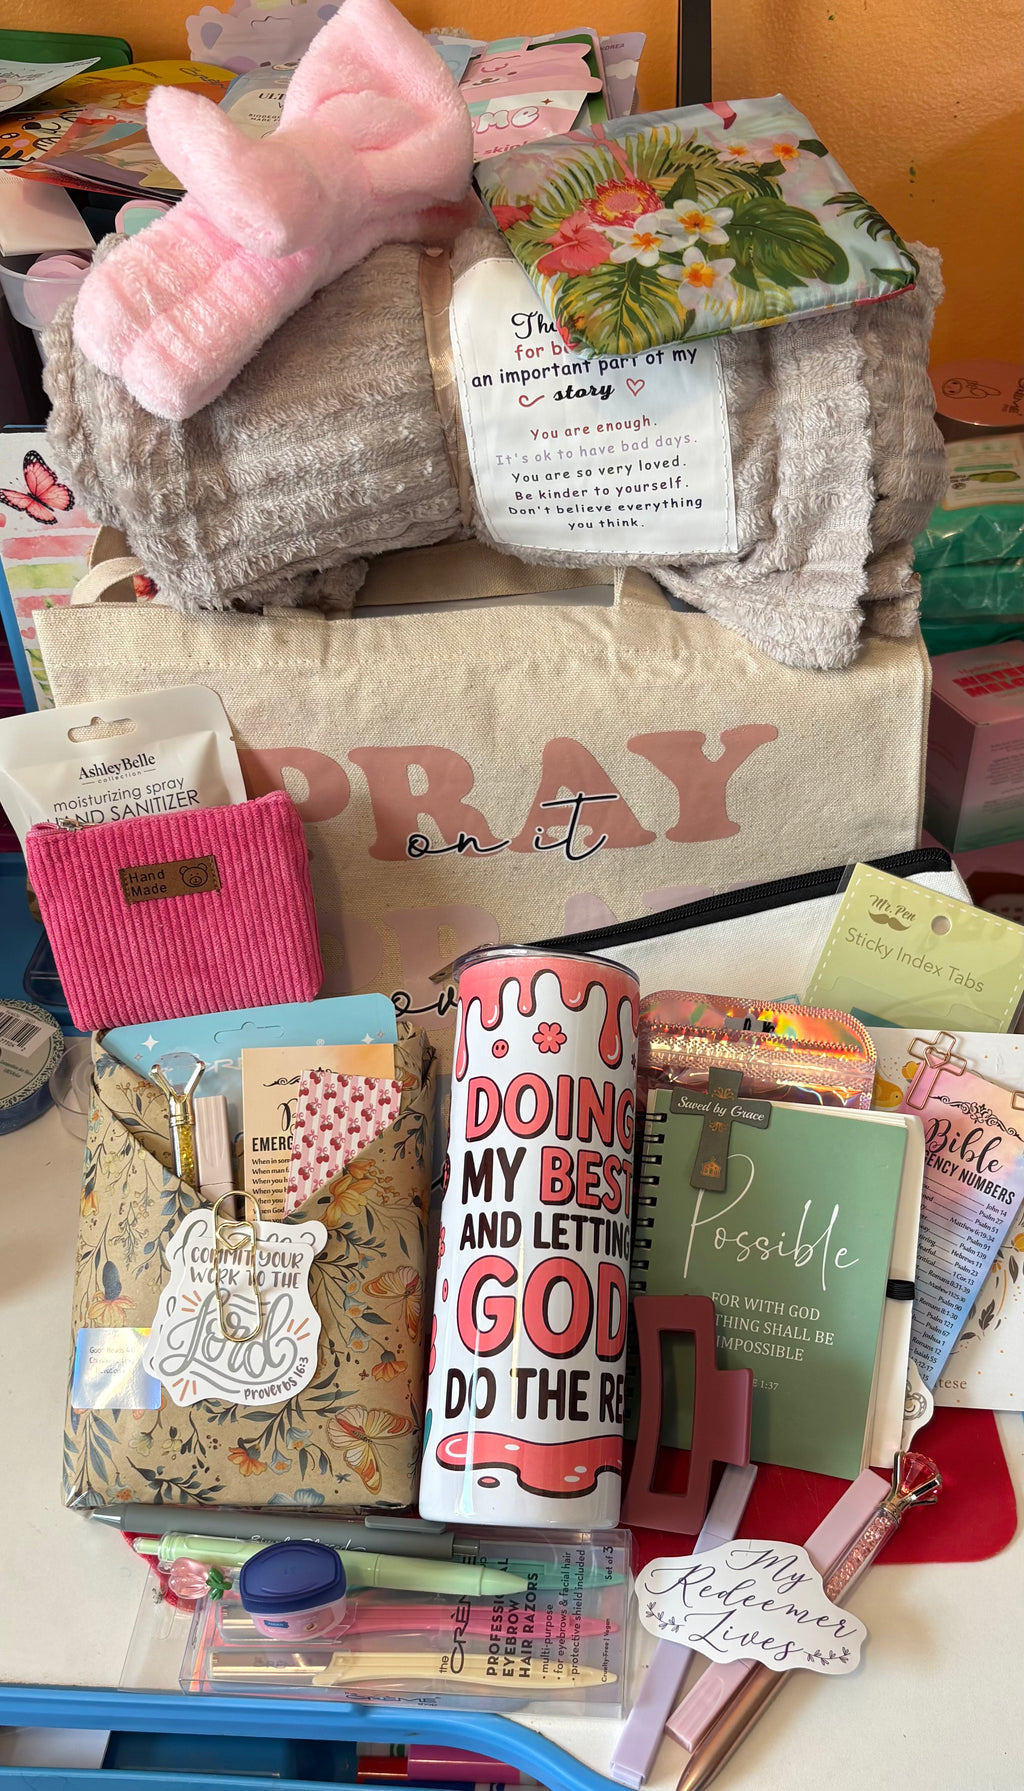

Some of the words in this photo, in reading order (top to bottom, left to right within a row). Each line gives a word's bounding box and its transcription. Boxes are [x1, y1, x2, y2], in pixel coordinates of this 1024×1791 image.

[258, 92, 287, 100] ULT
[514, 345, 544, 362] for
[471, 373, 492, 389] an
[499, 359, 592, 387] important
[598, 354, 640, 377] part
[646, 350, 665, 366] of
[672, 347, 698, 366] my
[553, 383, 616, 402] story
[530, 427, 558, 441] You
[564, 425, 591, 437] are
[596, 414, 657, 434] enough.
[495, 452, 529, 467] It's
[535, 449, 552, 463] ok
[557, 448, 574, 460] to
[579, 443, 616, 458] have
[621, 437, 649, 452] bad
[655, 431, 698, 448] days.
[511, 471, 539, 484] You
[545, 468, 571, 481] are
[576, 467, 593, 478] so
[598, 462, 633, 477] very
[638, 456, 687, 471] loved.
[515, 490, 533, 502] Be
[538, 485, 588, 500] kinder
[594, 484, 610, 496] to
[615, 476, 689, 496] yourself.
[508, 505, 551, 516] Don't
[556, 501, 612, 514] believe
[618, 497, 704, 513] everything
[568, 520, 594, 531] you
[599, 517, 645, 529] think.
[78, 753, 156, 781] AshleyBelle
[97, 771, 142, 784] collection
[53, 785, 143, 813] moisturizing
[146, 777, 185, 797] spray
[238, 723, 778, 862] PRAY
[110, 789, 199, 822] SANITIZER
[406, 832, 511, 858] on
[533, 791, 620, 862] it
[128, 869, 165, 884] Hand
[131, 883, 167, 898] Made
[869, 894, 893, 914] Mr.
[896, 904, 917, 922] Pen
[845, 927, 895, 960] Sticky
[896, 947, 944, 977] Index
[948, 965, 985, 993] Tabs
[465, 1072, 635, 1155] DOING
[677, 1096, 711, 1113] Saved
[713, 1101, 727, 1117] by
[730, 1105, 766, 1122] Grace
[925, 1117, 1002, 1174] Bible
[252, 1158, 270, 1166] When
[252, 1168, 270, 1176] When
[252, 1178, 271, 1186] When
[271, 1178, 283, 1187] you
[252, 1188, 271, 1196] When
[271, 1188, 283, 1196] you
[461, 1146, 527, 1205] MY
[539, 1145, 633, 1219] BEST
[958, 1167, 1016, 1206] NUMBERS
[271, 1198, 284, 1206] you
[272, 1206, 284, 1215] God
[985, 1203, 1000, 1214] John
[1000, 1209, 1008, 1217] 14
[949, 1216, 975, 1235] Matthew
[974, 1218, 992, 1231] Psalm
[991, 1226, 999, 1235] 51
[978, 1209, 996, 1222] Psalm
[995, 1217, 1004, 1226] 27
[460, 1210, 522, 1251] AND
[533, 1211, 631, 1262] LETTING
[966, 1235, 983, 1248] Psalm
[983, 1243, 991, 1252] 91
[190, 1246, 254, 1264] COMMIT
[257, 1250, 304, 1270] YOUR
[950, 1249, 975, 1266] Hebrews
[975, 1260, 983, 1269] 11
[959, 1242, 976, 1255] Psalm
[976, 1250, 987, 1261] 139
[189, 1266, 239, 1286] WORK
[271, 1270, 302, 1289] THE
[927, 1269, 950, 1286] Romans
[954, 1261, 971, 1275] Psalm
[970, 1270, 979, 1278] 23
[967, 1278, 975, 1287] 13
[456, 1254, 627, 1363] GOD
[711, 1291, 741, 1309] FOR
[744, 1297, 785, 1316] WITH
[788, 1304, 821, 1322] GOD
[918, 1297, 941, 1312] Romans
[937, 1296, 955, 1309] Psalm
[925, 1321, 943, 1335] Psalm
[926, 1311, 943, 1324] Psalm
[943, 1320, 954, 1329] 121
[763, 1321, 812, 1343] SHALL
[814, 1330, 835, 1346] BE
[922, 1330, 941, 1345] Joshua
[716, 1335, 805, 1362] IMPOSSIBLE
[911, 1336, 935, 1352] Romans
[934, 1347, 942, 1356] 12
[913, 1347, 930, 1360] Isaiah
[929, 1355, 938, 1364] 55
[294, 1356, 309, 1380] 16:3
[444, 1367, 497, 1420] DO
[509, 1367, 590, 1421] THE
[760, 1379, 780, 1391] 1:37
[563, 1551, 571, 1570] hair
[603, 1546, 614, 1554] 3
[606, 1554, 613, 1567] of
[576, 1549, 586, 1591] included
[725, 1549, 813, 1594] My
[561, 1574, 570, 1597] facial
[522, 1573, 539, 1634] RAZORS
[559, 1598, 568, 1607] &
[575, 1593, 583, 1621] shield
[644, 1564, 858, 1639] Redeemer
[503, 1600, 520, 1677] EYEBROW
[540, 1604, 554, 1673] multi-purpose
[558, 1609, 568, 1657] eyebrows
[684, 1609, 804, 1661] Lives
[519, 1641, 533, 1678] HAIR
[572, 1623, 581, 1675] protective
[601, 1639, 610, 1682] Cruelty-Free
[439, 1656, 450, 1674] the
[554, 1658, 564, 1675] for
